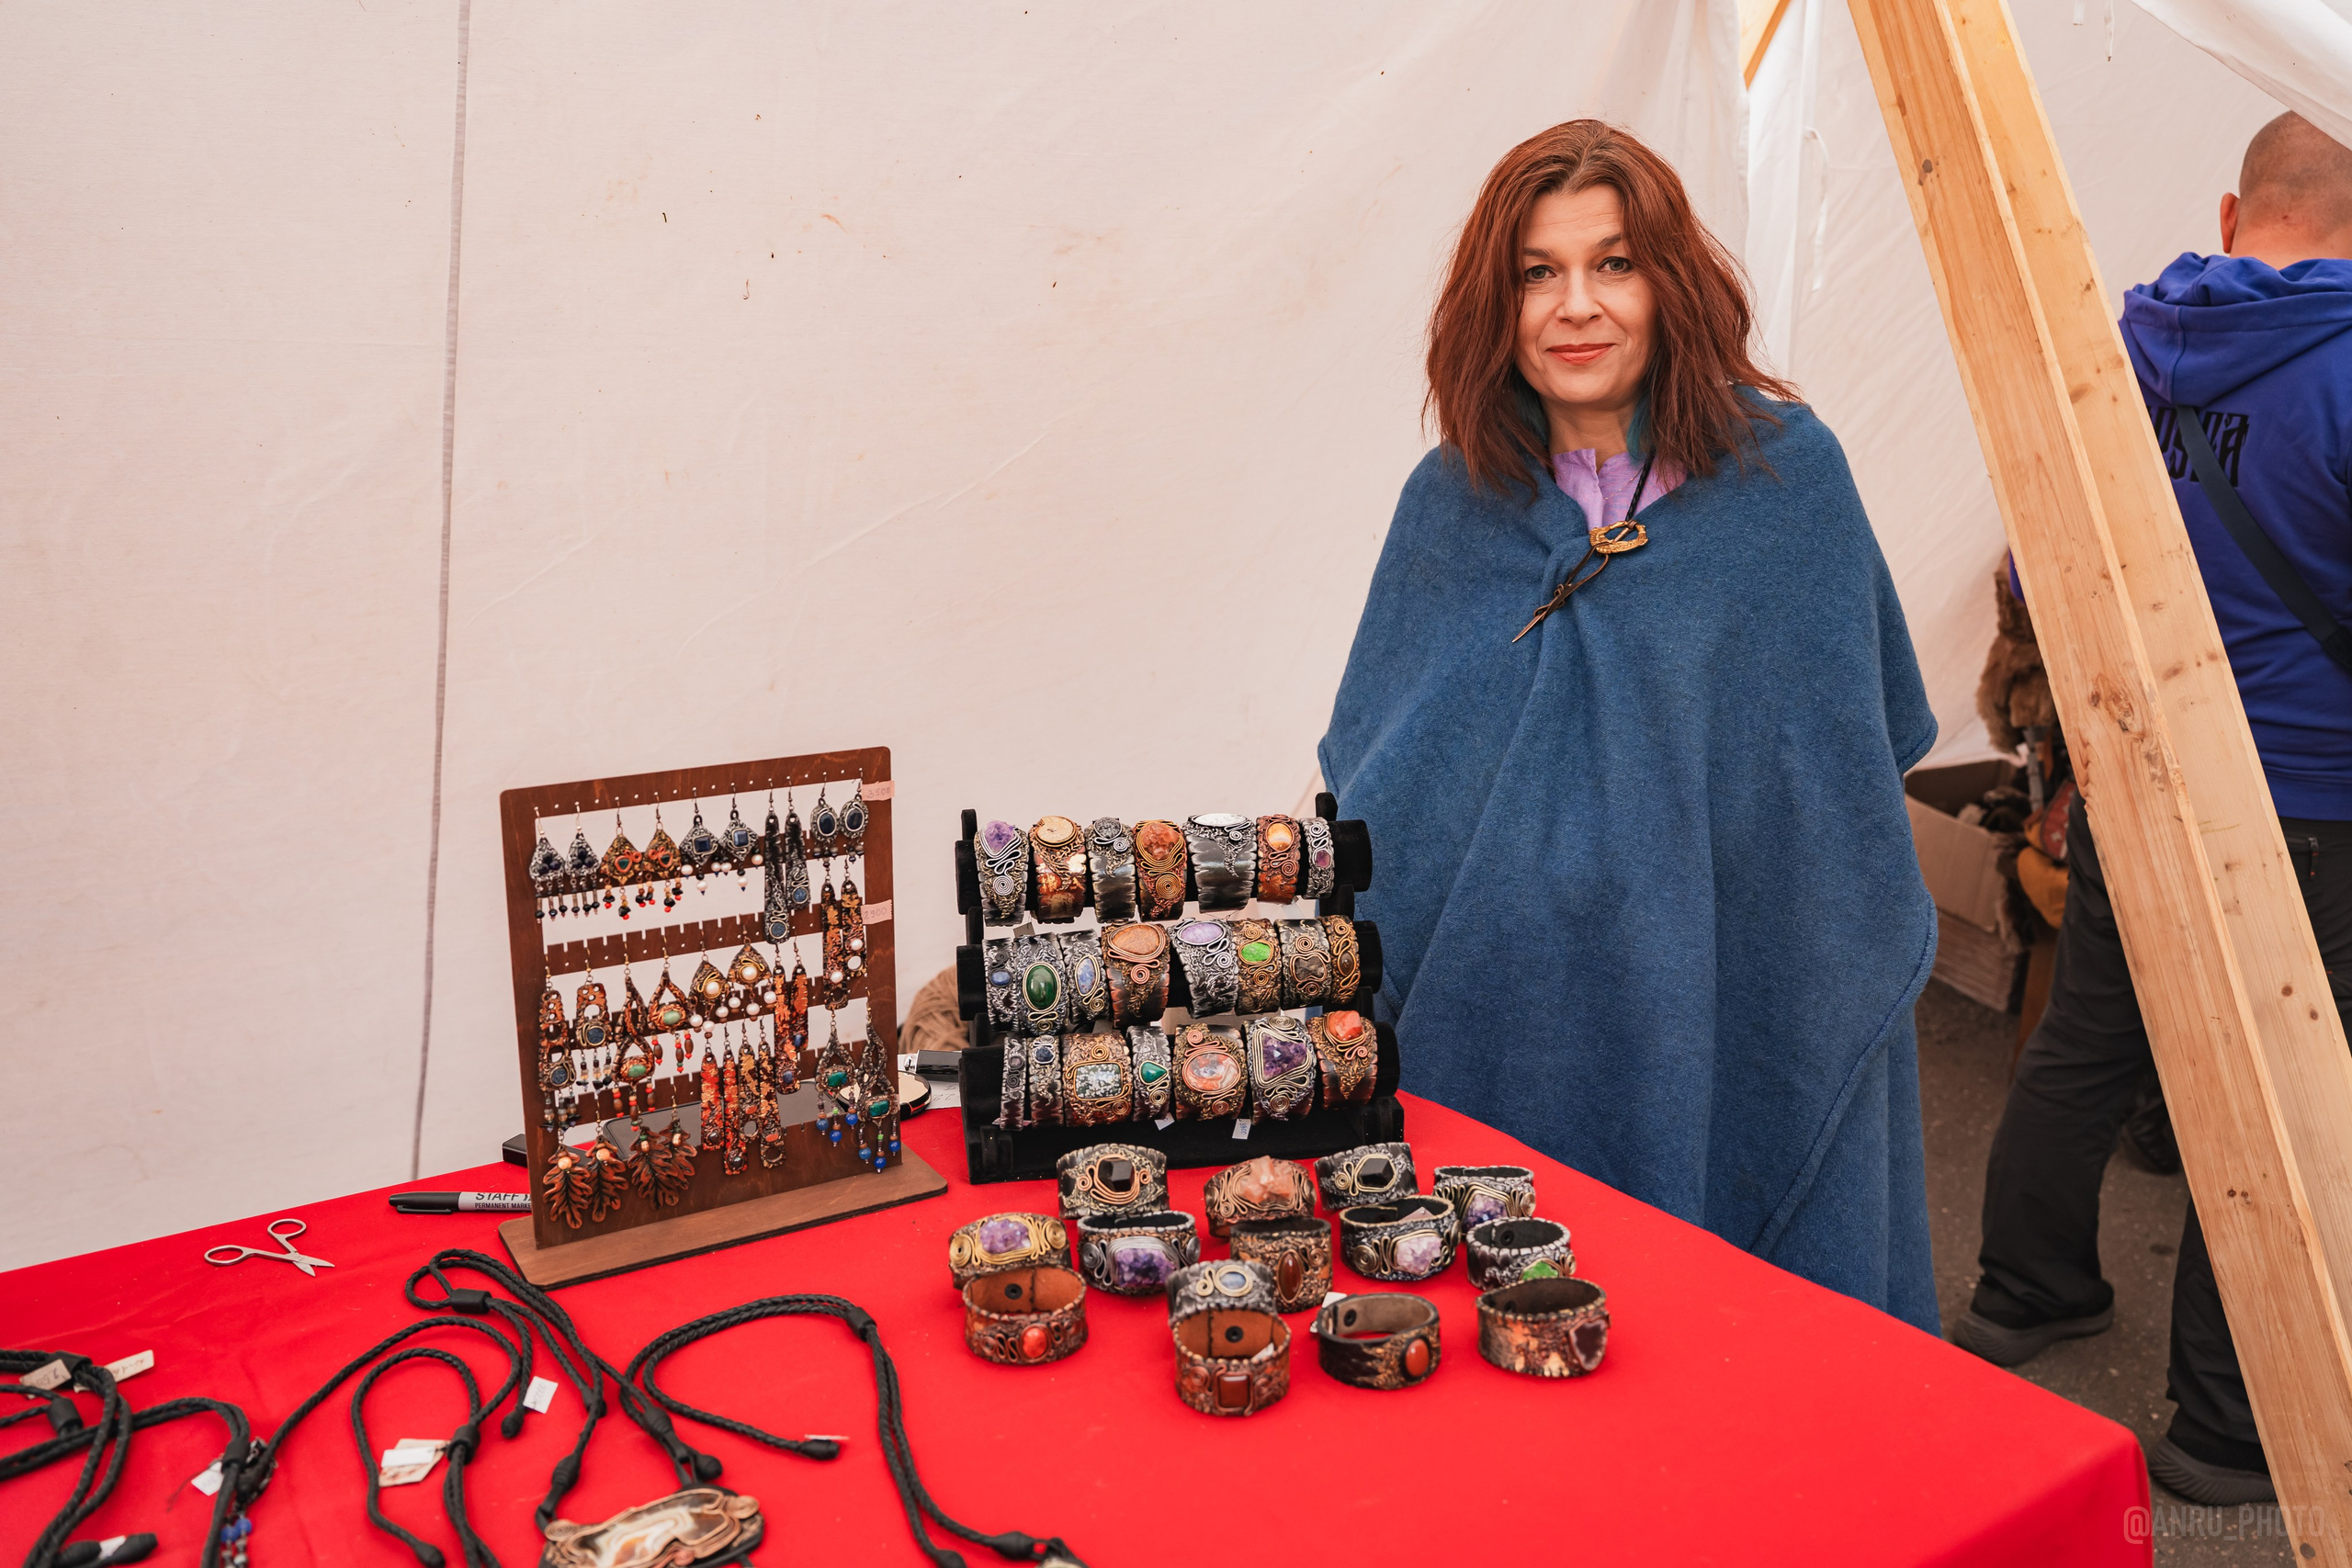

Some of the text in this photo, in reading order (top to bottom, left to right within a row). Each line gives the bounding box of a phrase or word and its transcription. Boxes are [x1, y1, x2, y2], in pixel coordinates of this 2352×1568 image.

[867, 787, 892, 798] 3500
[864, 907, 888, 919] 2900
[475, 1193, 519, 1201] STAFF
